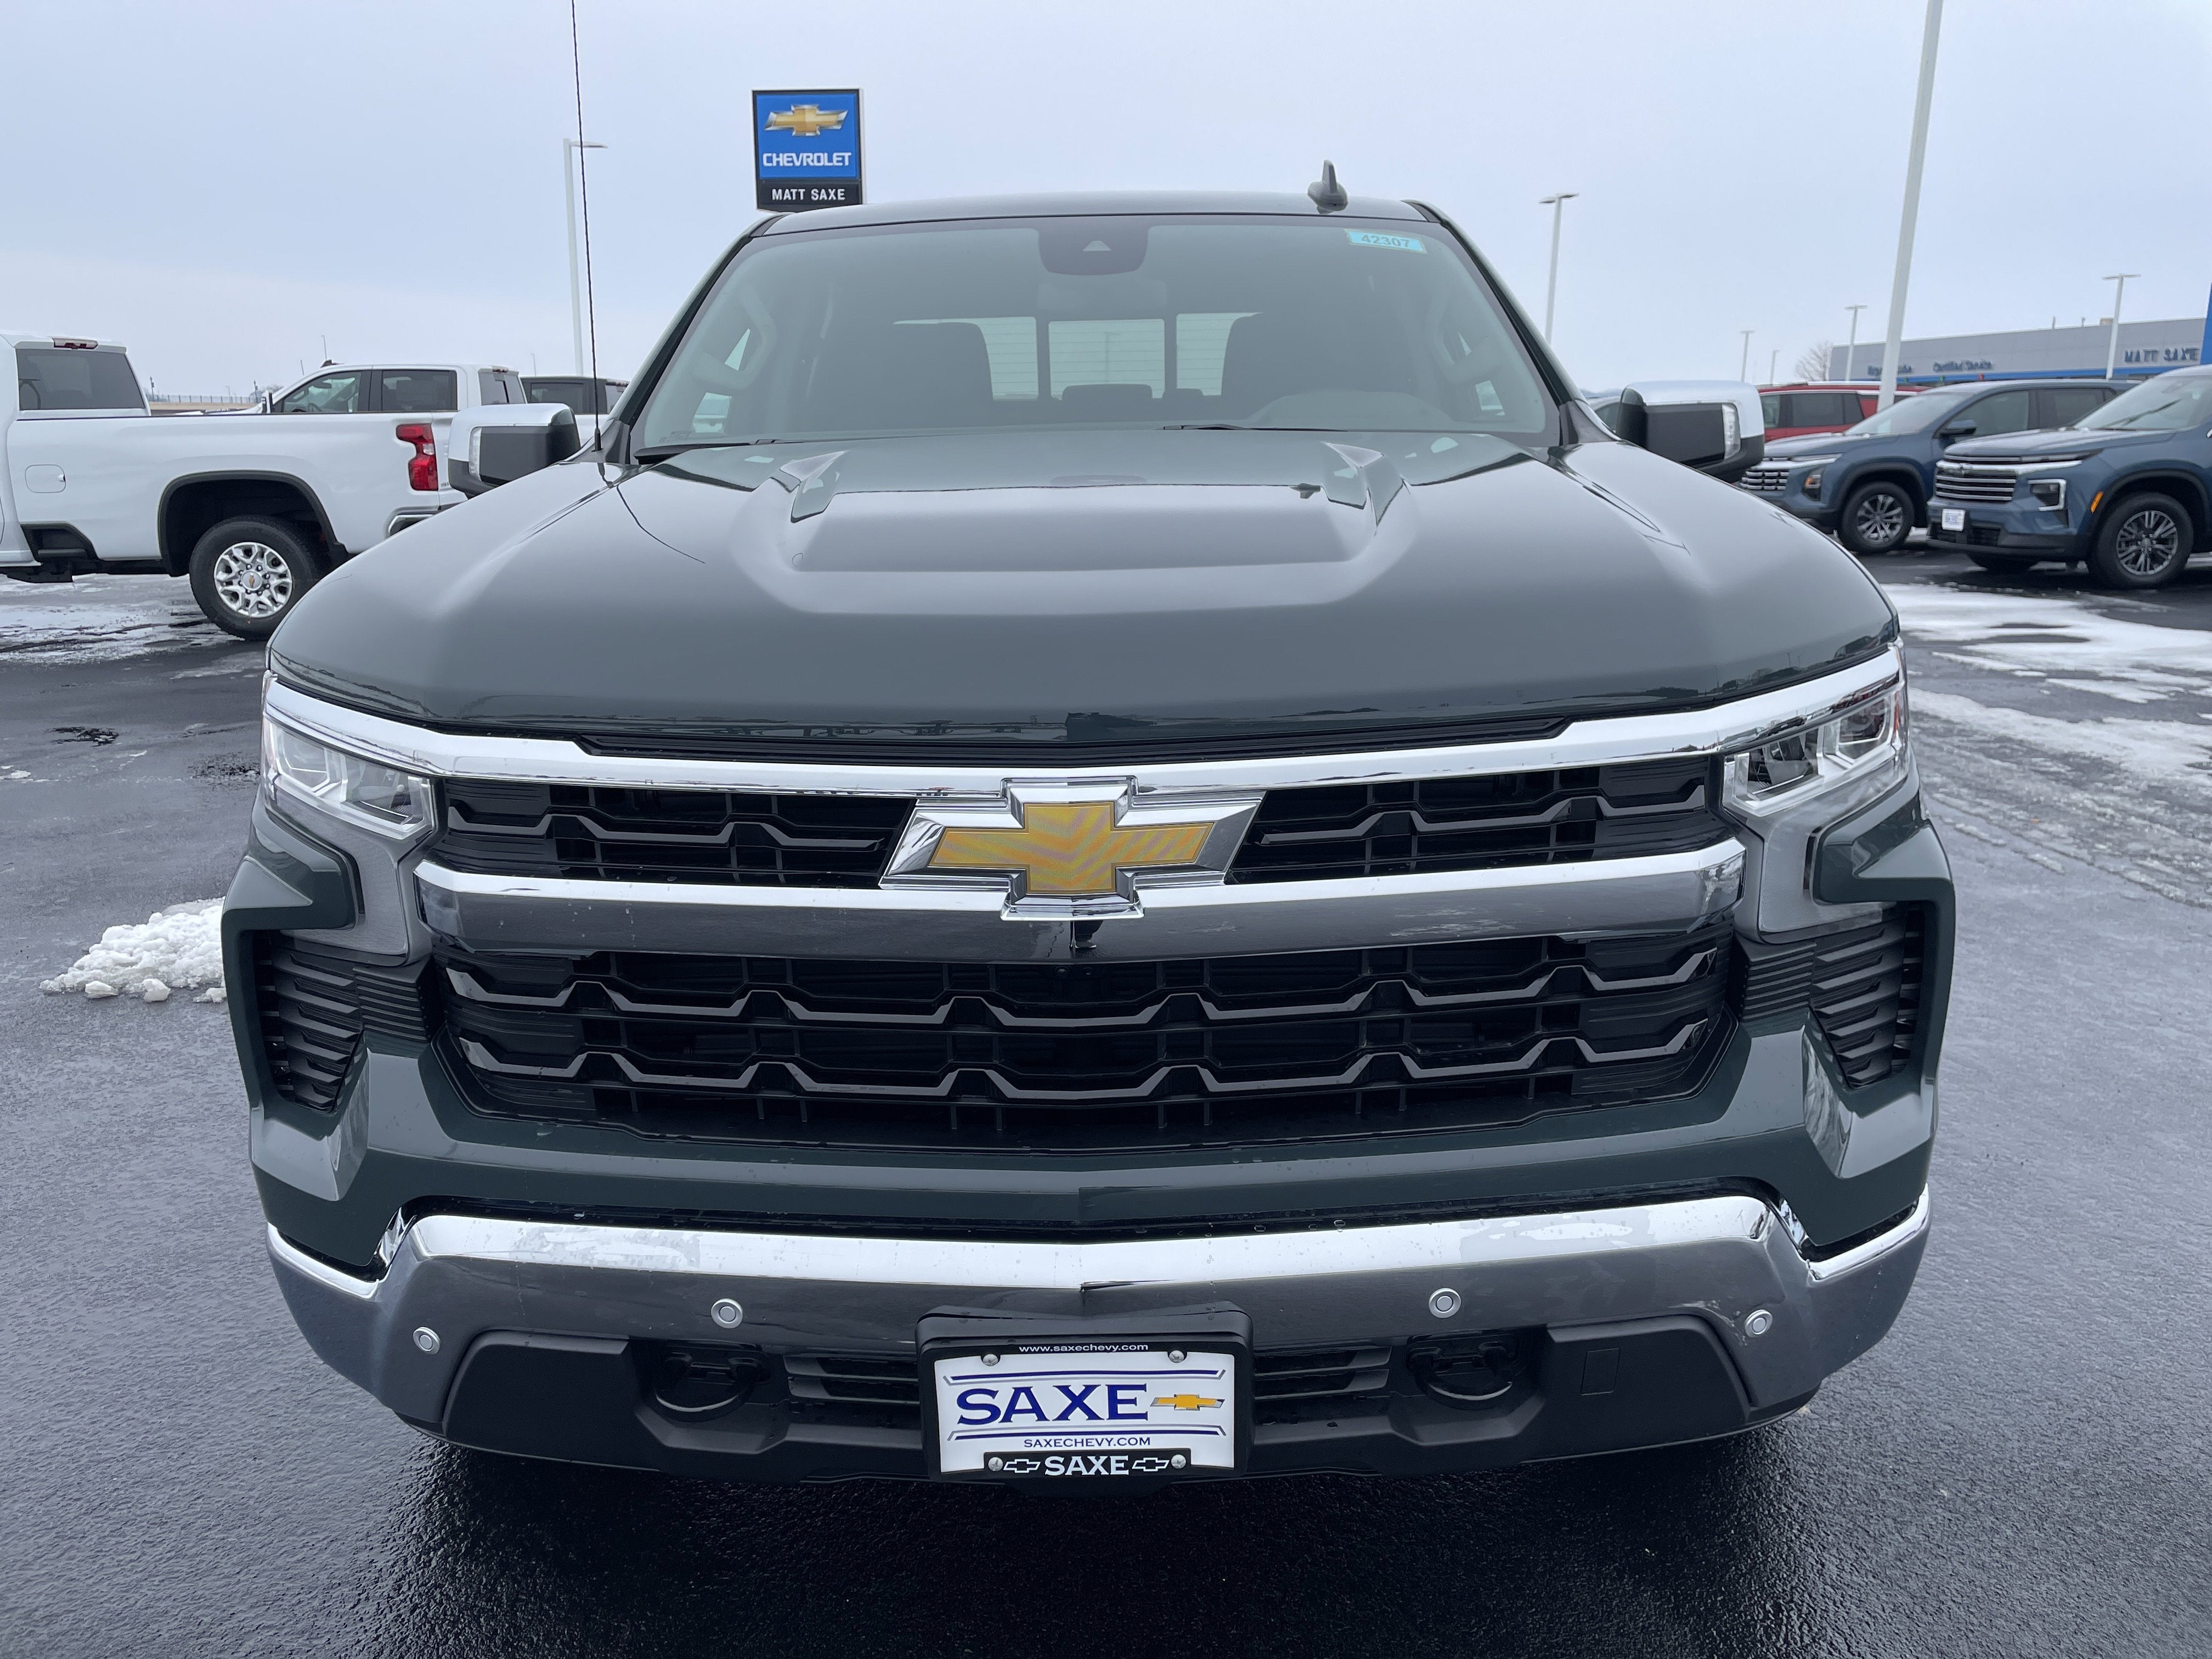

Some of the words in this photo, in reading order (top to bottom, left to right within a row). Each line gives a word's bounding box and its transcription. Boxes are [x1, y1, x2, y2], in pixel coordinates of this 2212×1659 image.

[763, 152, 851, 167] CHEVROLET
[771, 189, 805, 200] MATT
[811, 188, 846, 200] SAXE
[1362, 234, 1409, 247] 42307
[1019, 1344, 1148, 1352] www.saxechevy.com
[956, 1383, 1148, 1425] SAXE
[1024, 1437, 1150, 1448] SAXECHEVY.COM
[1045, 1455, 1129, 1476] SAXE
